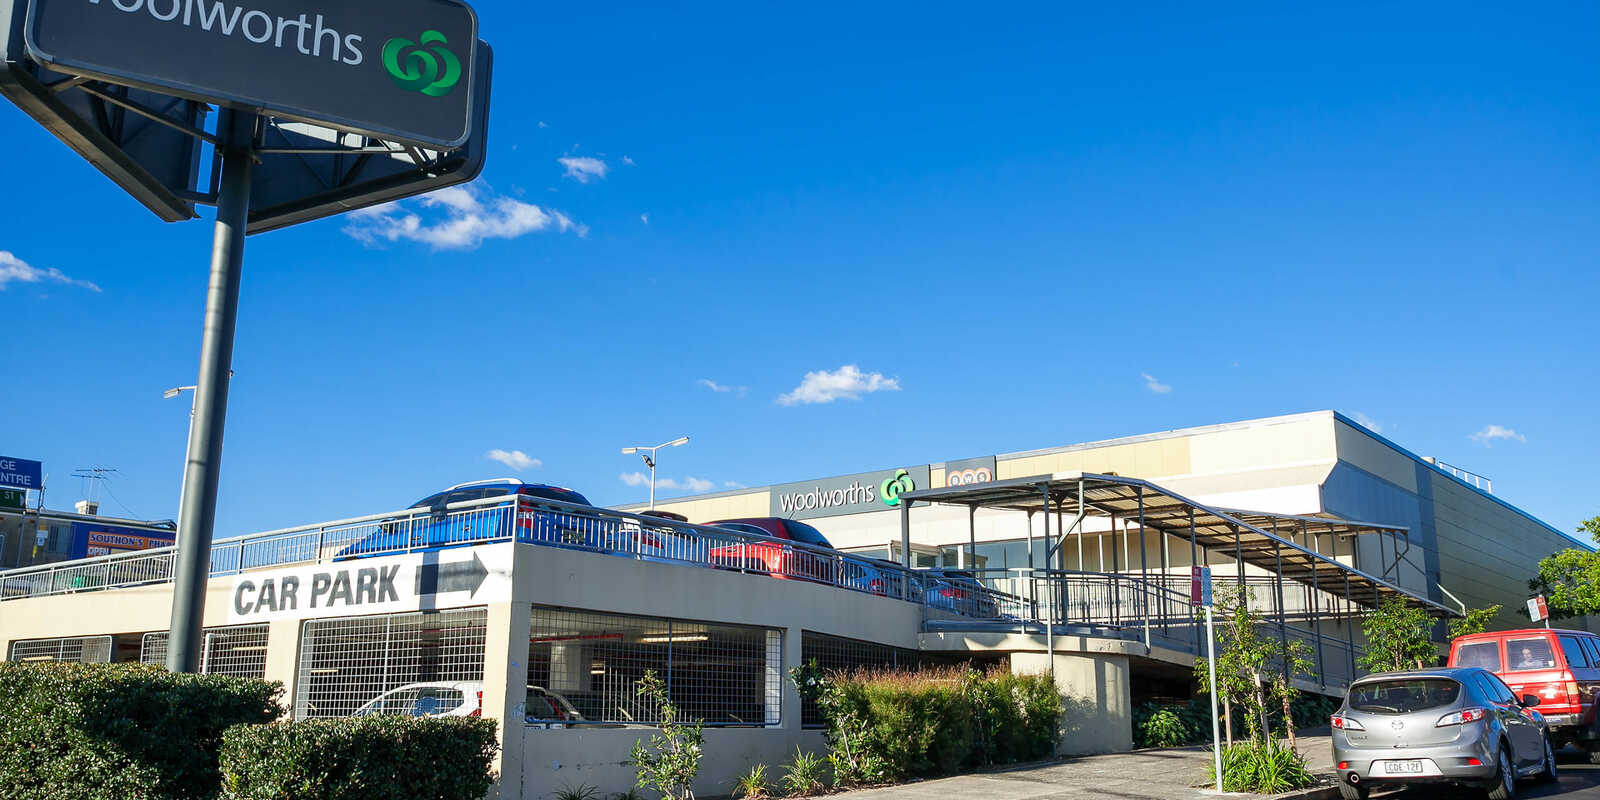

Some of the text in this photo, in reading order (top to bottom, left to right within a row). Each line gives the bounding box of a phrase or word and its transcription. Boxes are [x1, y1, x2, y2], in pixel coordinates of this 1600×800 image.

[780, 481, 875, 513] Woolworths
[87, 546, 109, 556] OPEN
[90, 533, 144, 547] SOUTHON'S
[234, 564, 401, 616] CAR PARK
